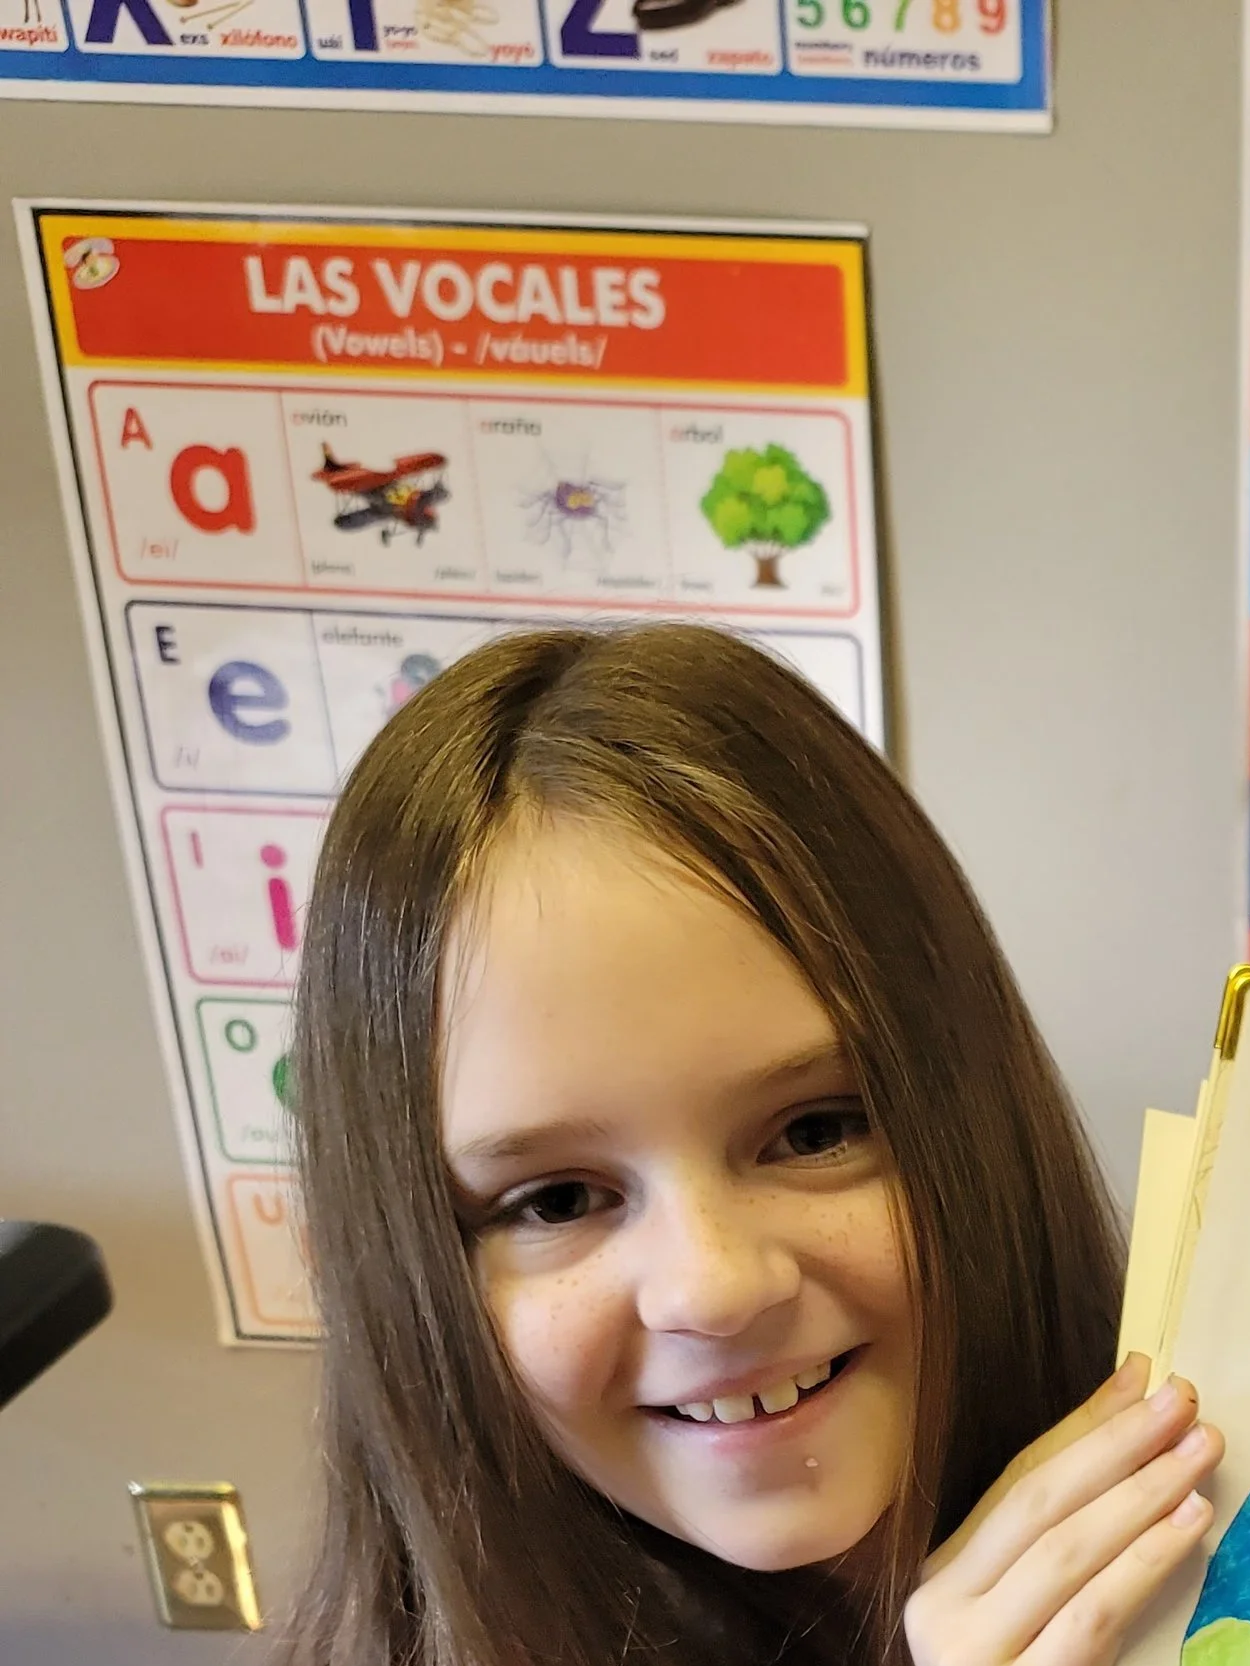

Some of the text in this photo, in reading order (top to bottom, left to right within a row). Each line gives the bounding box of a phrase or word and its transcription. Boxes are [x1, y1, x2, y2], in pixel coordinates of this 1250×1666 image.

[244, 254, 667, 330] LAS VOCALES
[312, 325, 444, 368] (Vowels)
[121, 407, 153, 450] A
[170, 444, 257, 535] a
[155, 625, 181, 666] E
[207, 660, 292, 746] e
[260, 843, 297, 951] i
[224, 1018, 256, 1052] O
